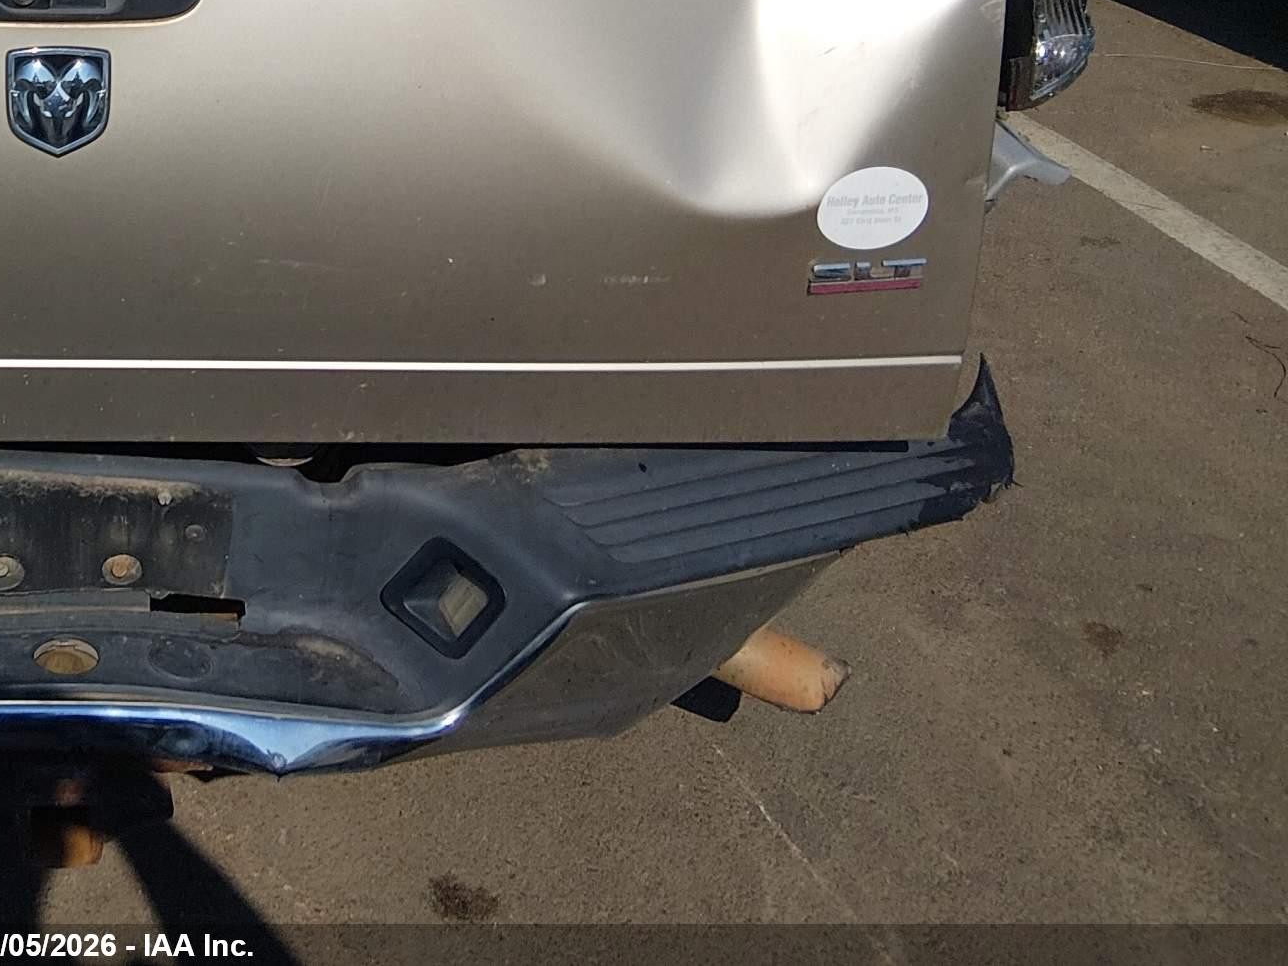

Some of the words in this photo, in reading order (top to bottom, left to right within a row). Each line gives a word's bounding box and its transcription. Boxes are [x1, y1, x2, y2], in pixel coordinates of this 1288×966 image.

[862, 194, 885, 205] Auto
[888, 193, 924, 204] Center
[811, 258, 927, 282] SLT
